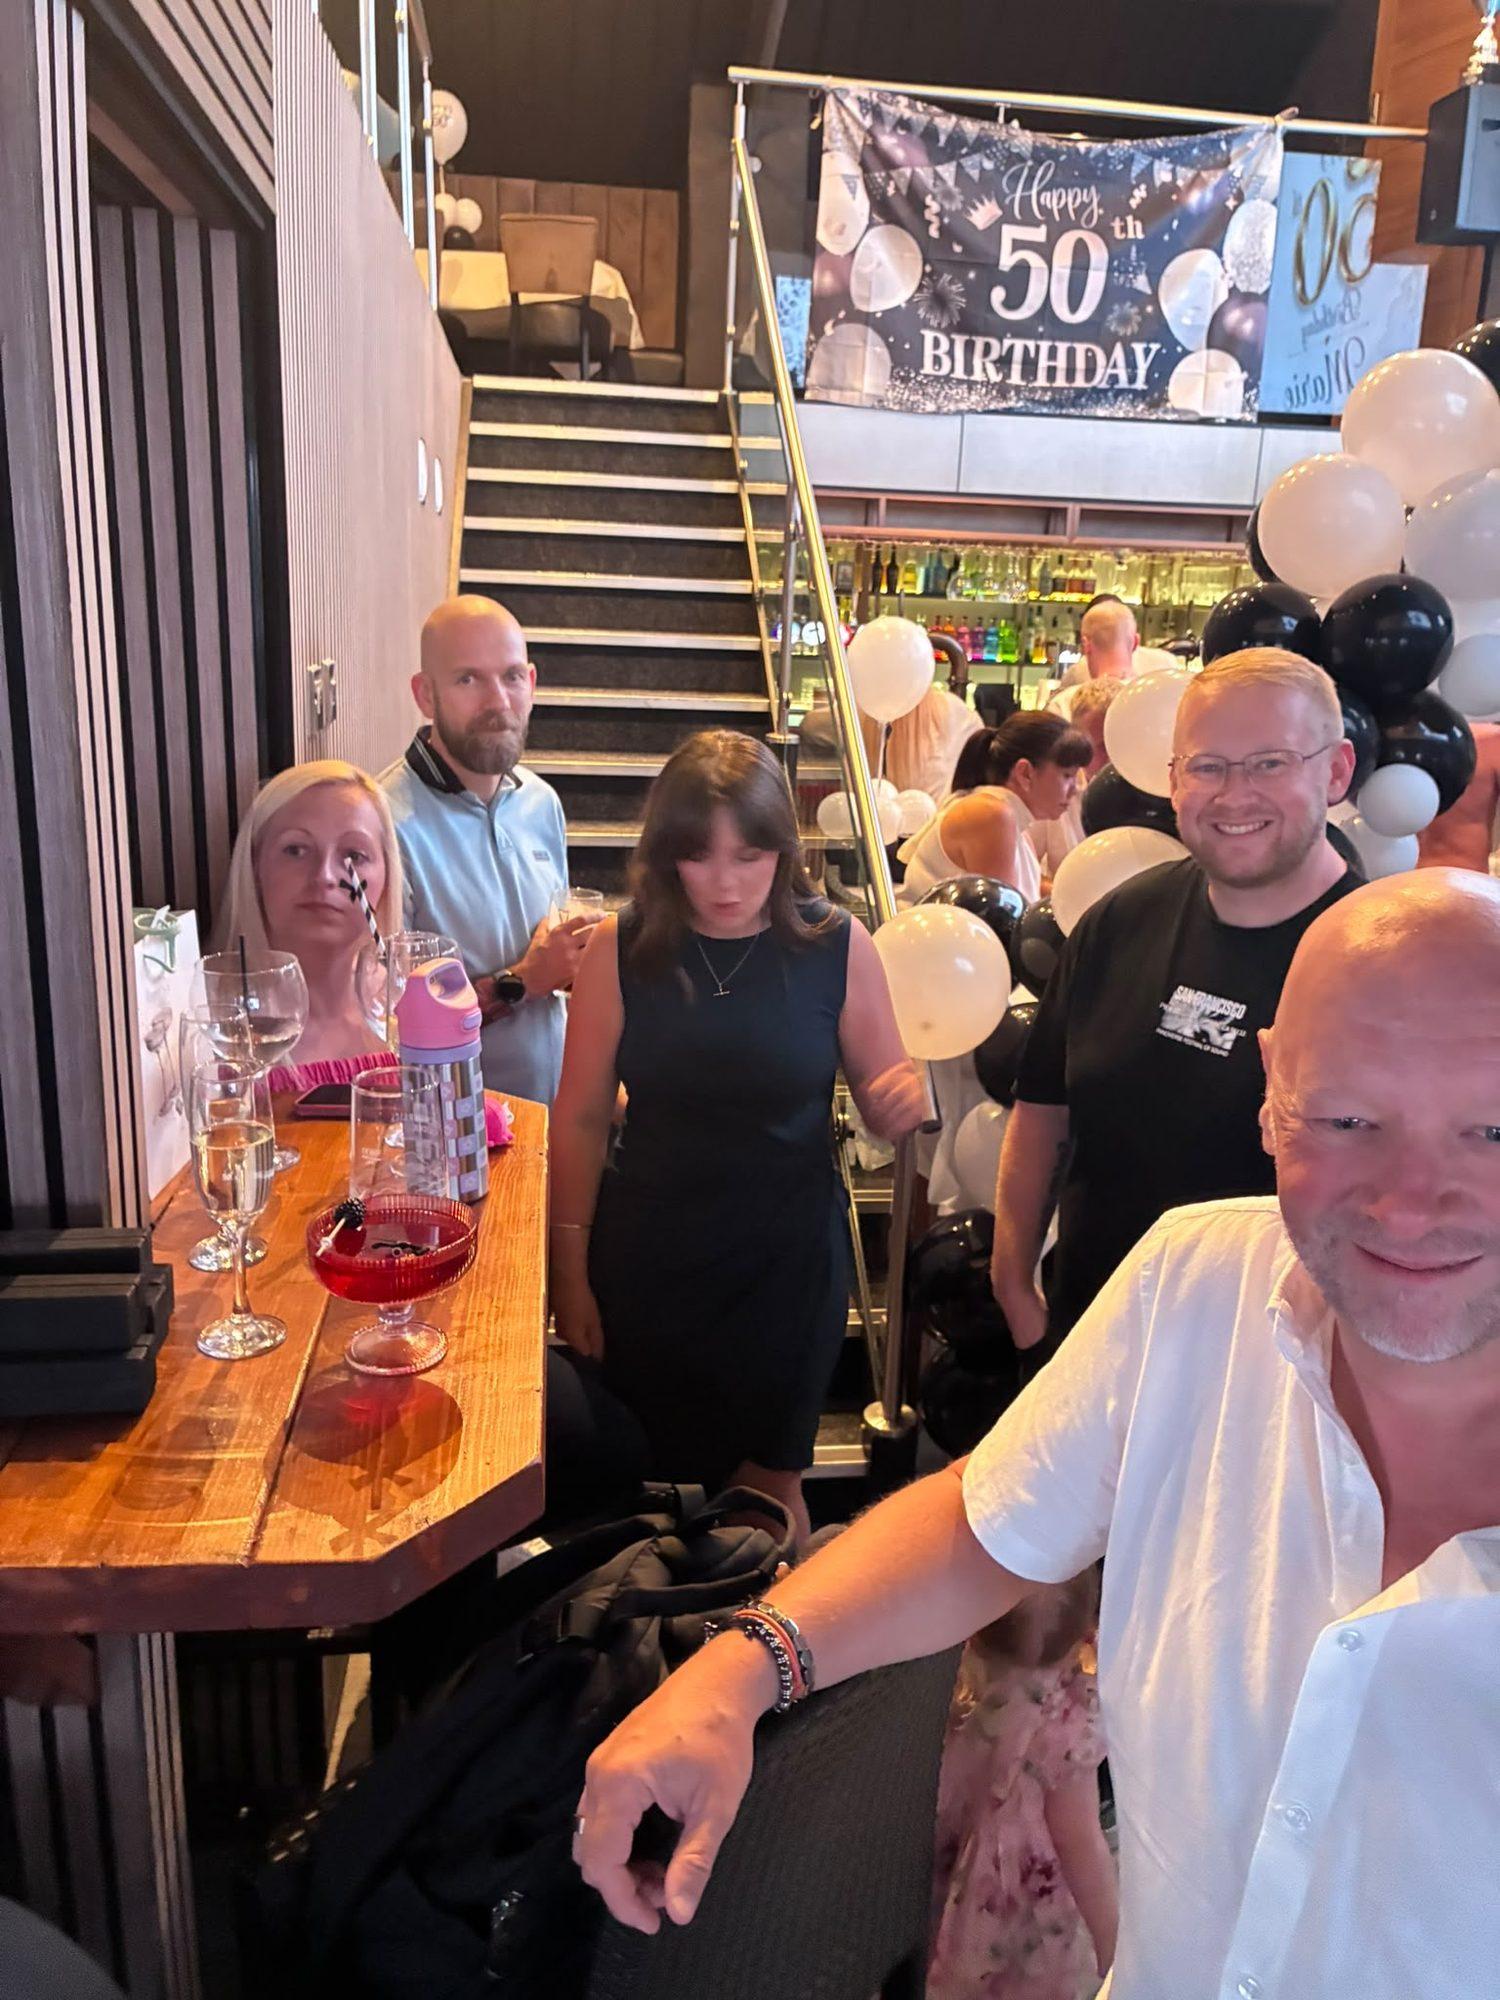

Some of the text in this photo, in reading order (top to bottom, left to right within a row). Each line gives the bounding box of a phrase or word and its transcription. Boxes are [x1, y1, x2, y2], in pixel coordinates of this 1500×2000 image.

[1001, 160, 1100, 229] Happy
[990, 214, 1145, 324] 50 th
[920, 329, 1162, 390] BIRTHDAY
[1193, 990, 1247, 1019] FRANCISCO
